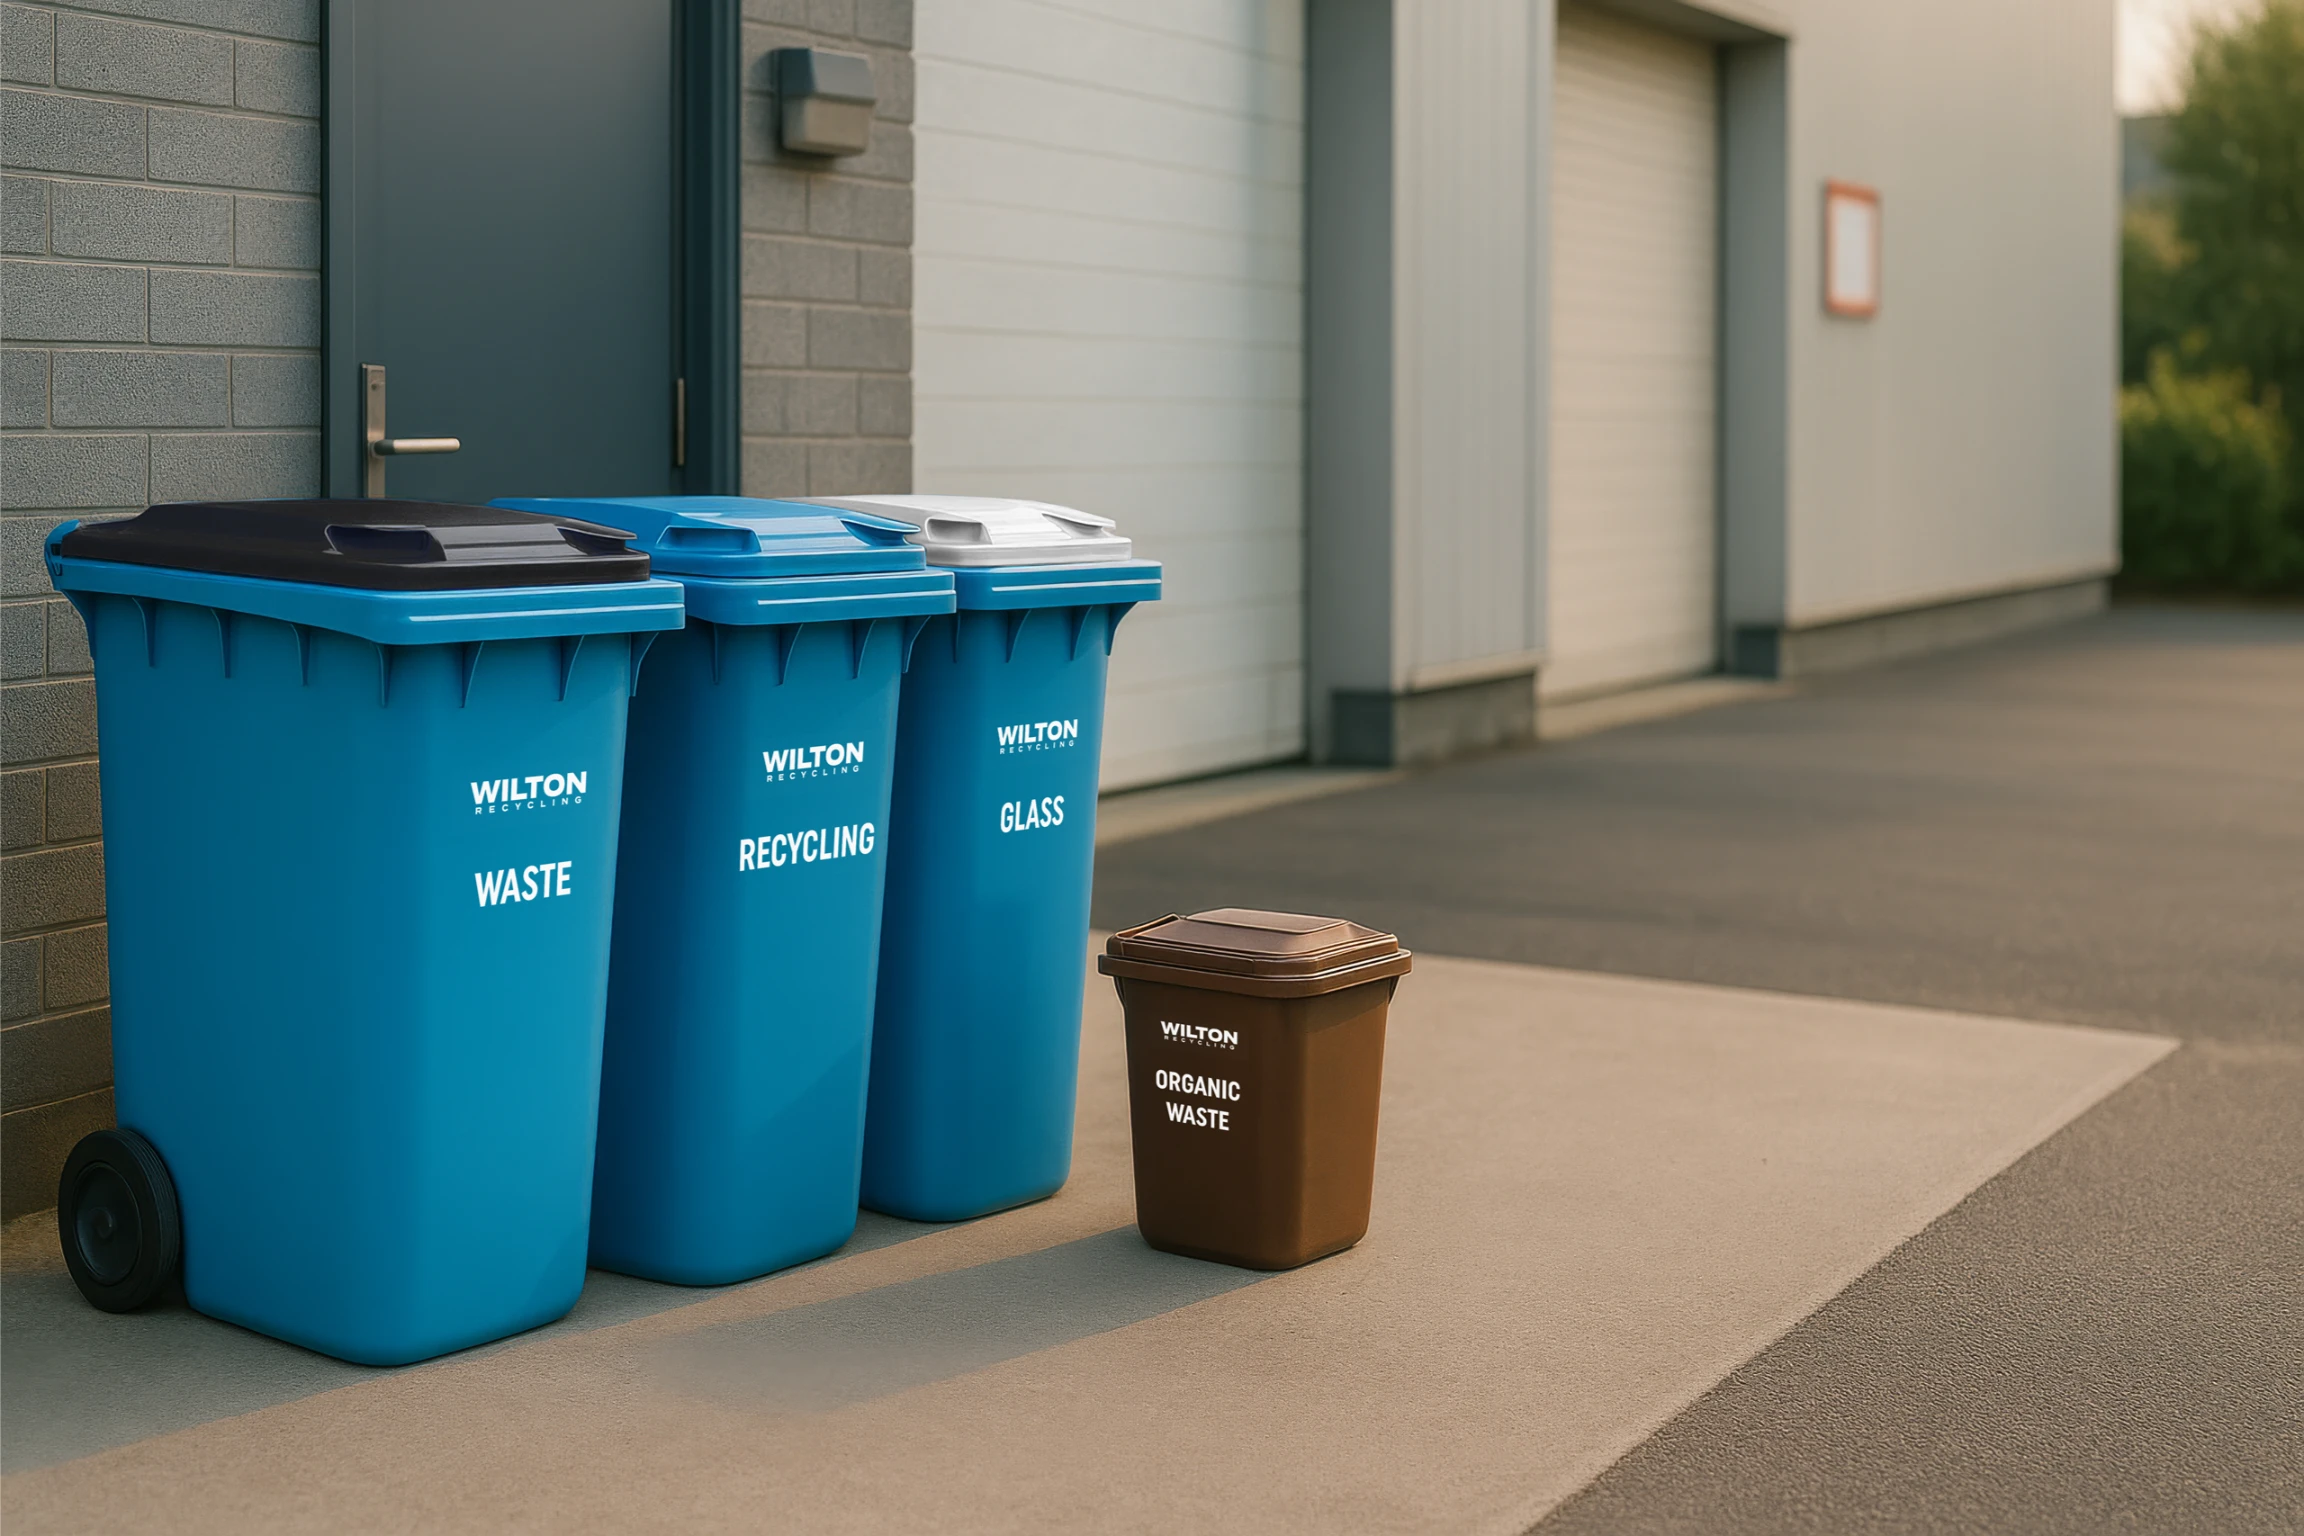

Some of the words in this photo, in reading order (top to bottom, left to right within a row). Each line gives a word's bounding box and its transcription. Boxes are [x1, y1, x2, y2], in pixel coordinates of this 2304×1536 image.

[998, 719, 1079, 746] WILTON
[999, 740, 1075, 755] RECYCLING
[762, 741, 865, 773] WILTON
[470, 771, 588, 805] WILTON
[766, 765, 860, 783] RECYCLING
[474, 796, 583, 815] RECYCLING
[999, 795, 1065, 834] GLASS
[739, 823, 875, 872] RECYCLING
[474, 861, 573, 908] WASTE
[1160, 1020, 1239, 1045] WILTON
[1163, 1034, 1236, 1051] RECYCLING
[1155, 1069, 1241, 1102] ORGANIC
[1165, 1102, 1230, 1132] WASTE
